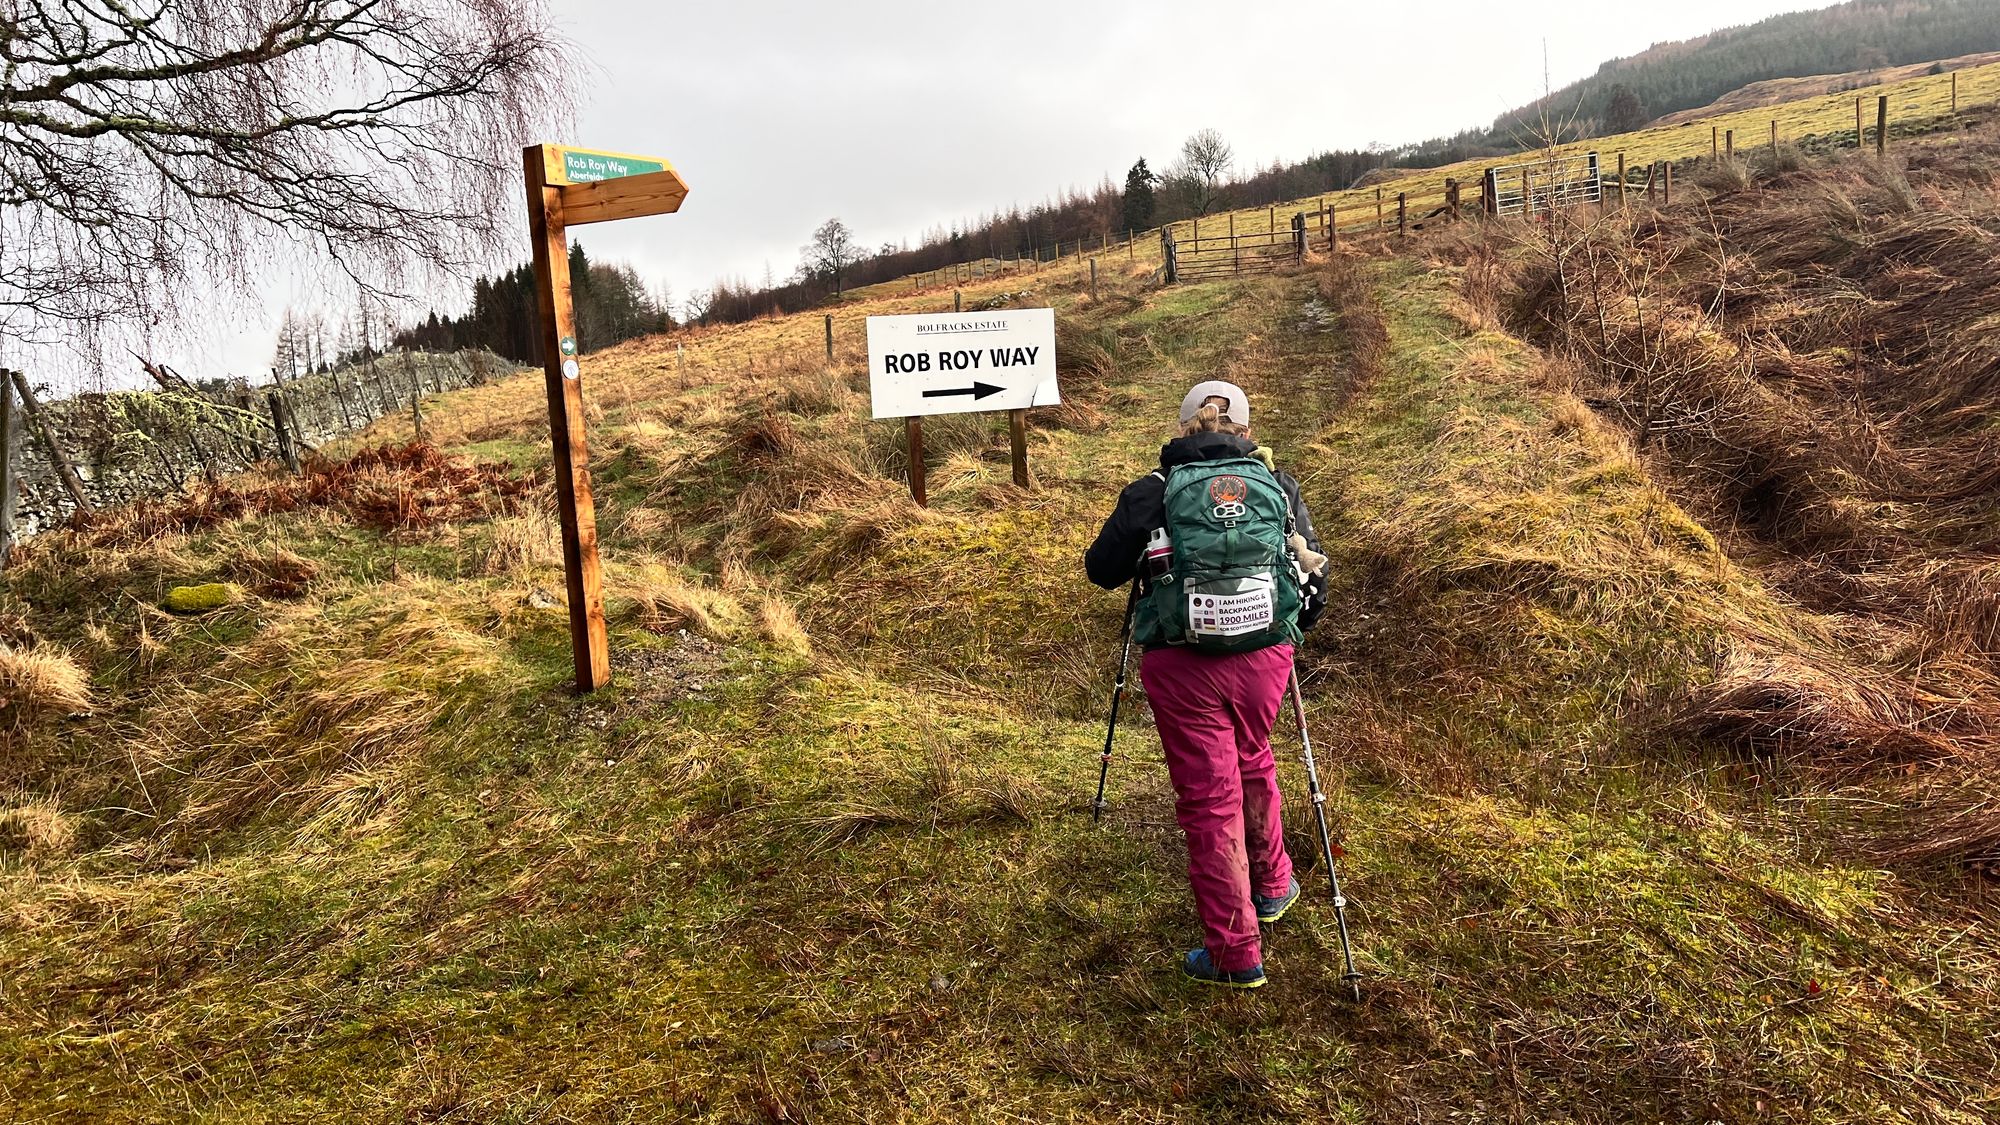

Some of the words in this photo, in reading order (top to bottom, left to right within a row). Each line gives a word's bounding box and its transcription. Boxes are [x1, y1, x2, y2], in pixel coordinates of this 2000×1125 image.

[567, 156, 586, 169] Rob
[588, 159, 605, 174] Roy
[607, 161, 628, 177] Way
[917, 322, 973, 333] BOLFRACKS
[975, 320, 1008, 330] ESTATE
[885, 353, 931, 374] ROB
[939, 349, 983, 370] ROY
[990, 346, 1039, 368] WAY
[1236, 594, 1260, 605] HIKING
[1219, 602, 1268, 615] BACKPACKING
[1220, 615, 1241, 624] 1900
[1243, 610, 1269, 622] MILES
